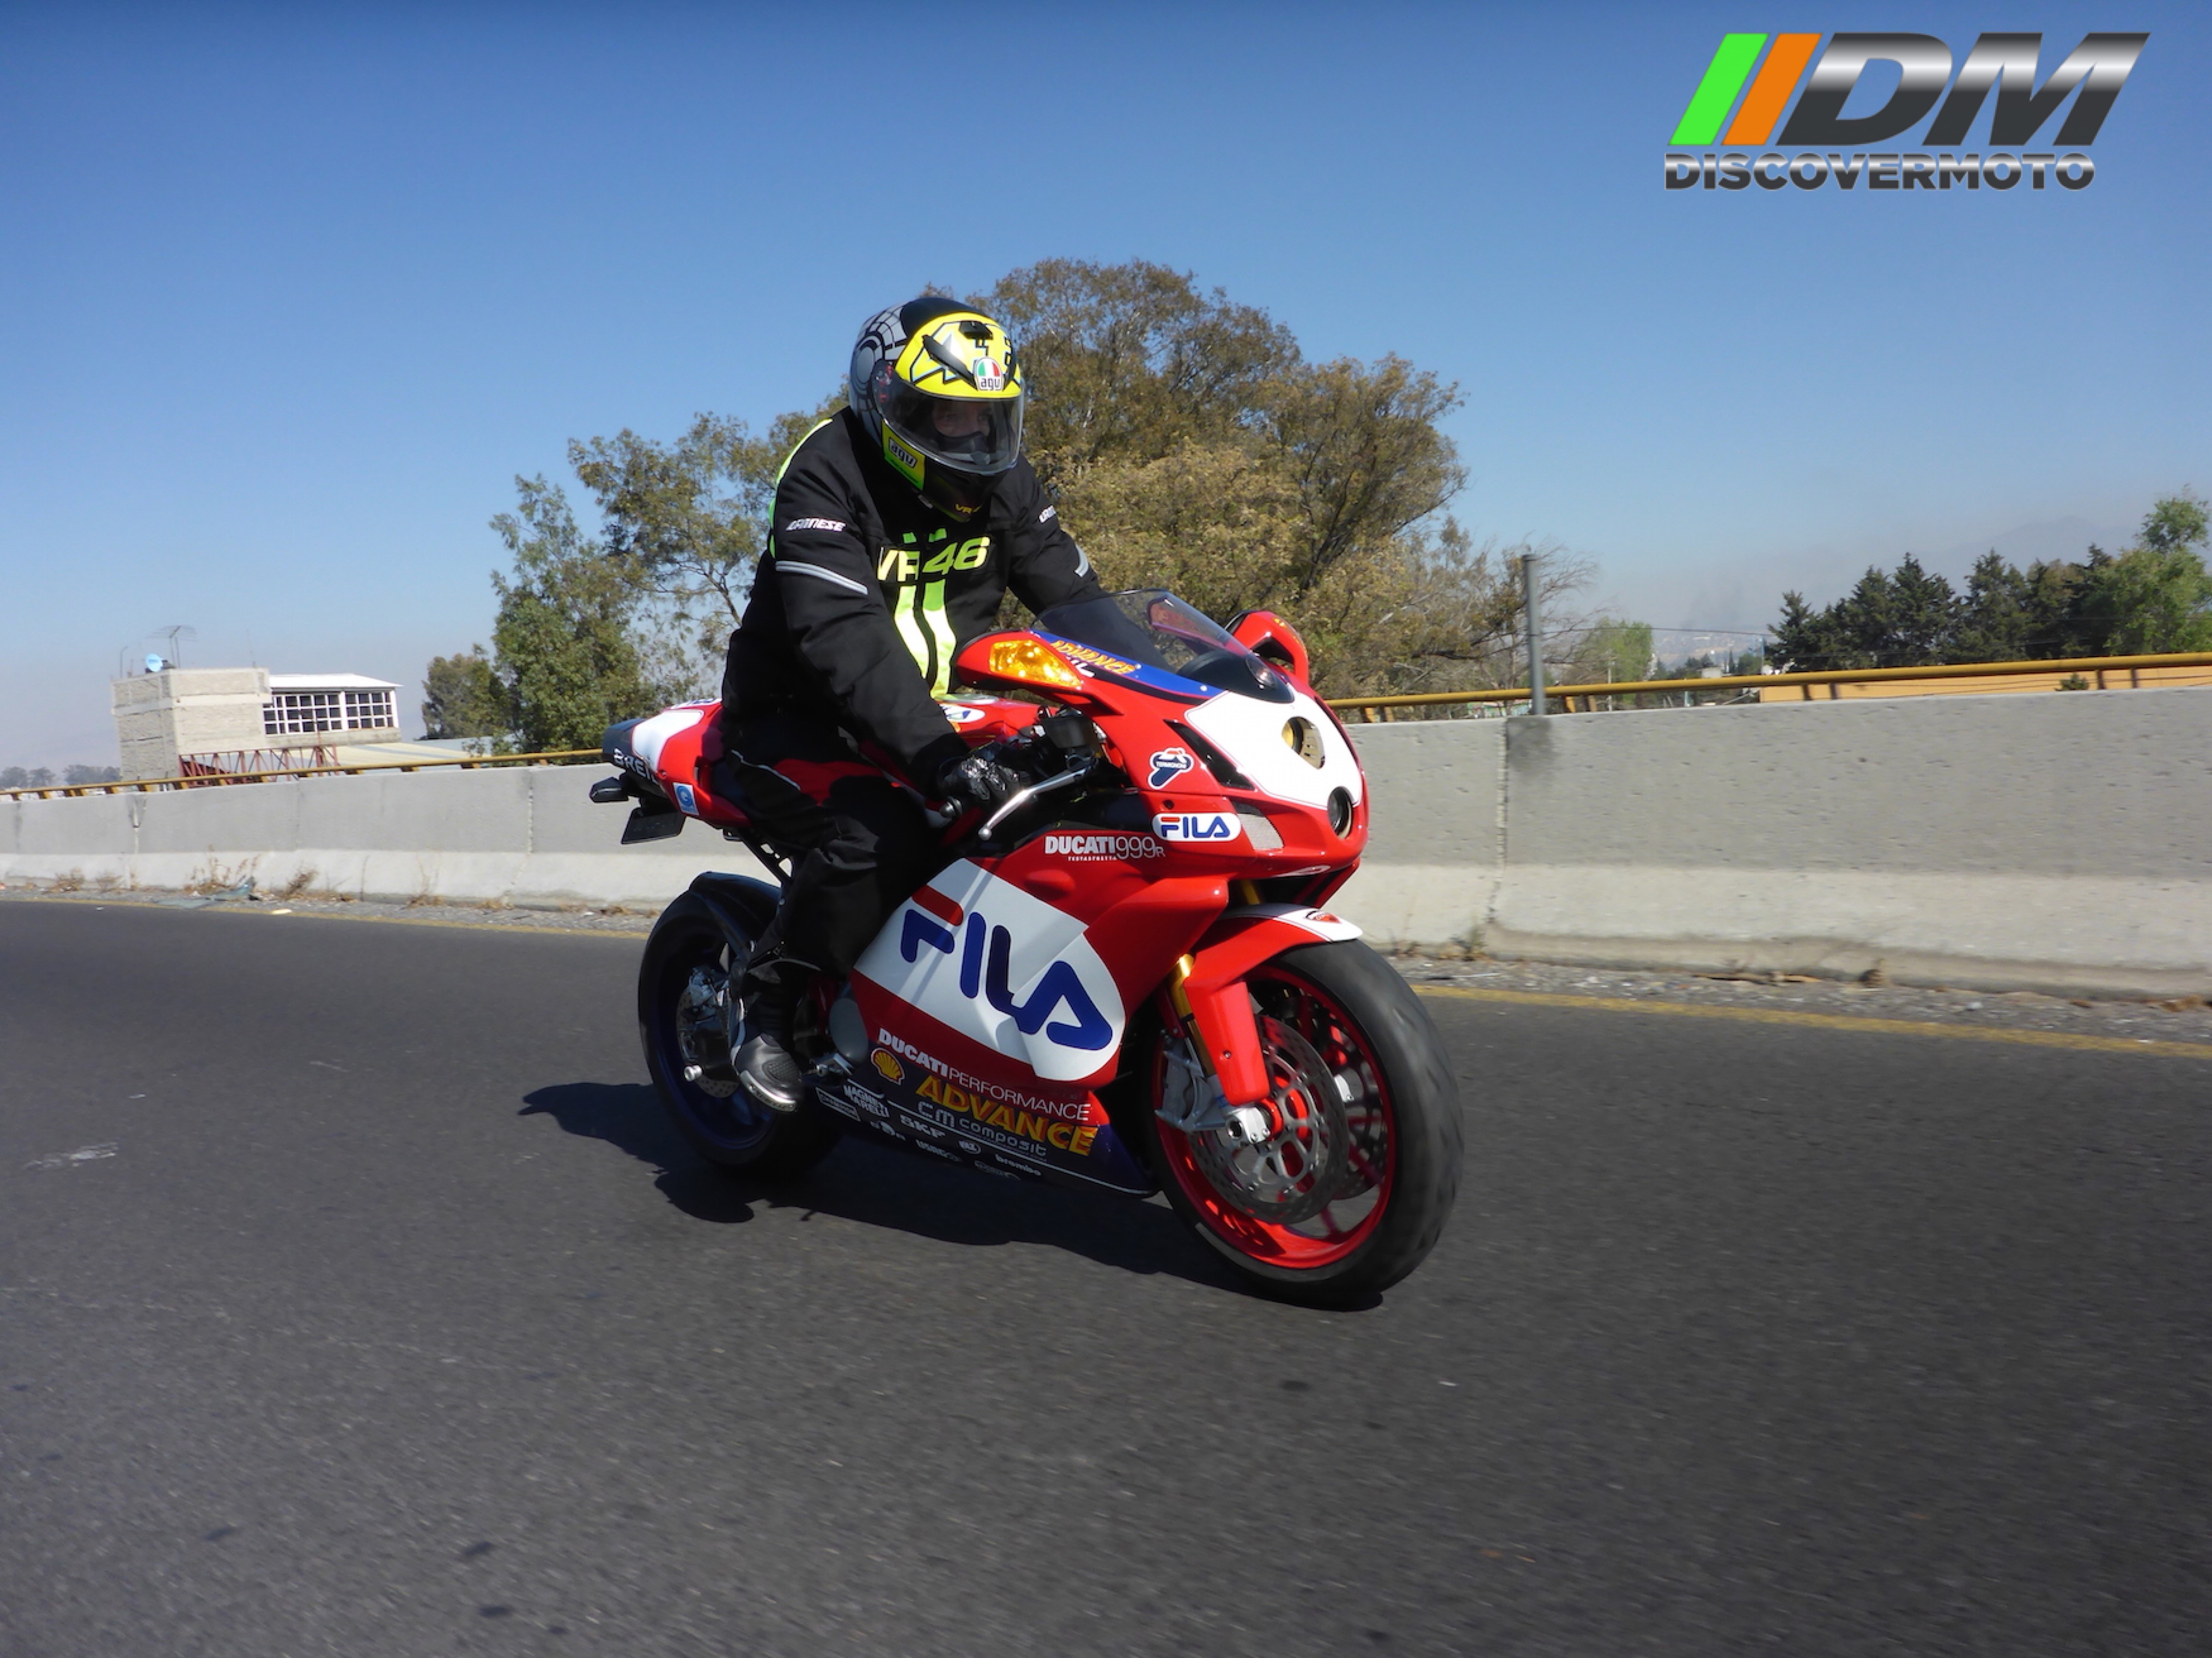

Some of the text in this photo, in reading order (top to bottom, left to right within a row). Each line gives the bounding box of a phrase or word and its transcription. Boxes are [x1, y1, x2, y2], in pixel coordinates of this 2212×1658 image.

[1050, 639, 1136, 674] ADVANCE
[1160, 816, 1231, 838] FILA
[1045, 835, 1115, 855] DUCATI
[900, 885, 1113, 1051] FILA
[878, 1027, 1091, 1121] DUCATI PERFORMANCE
[899, 1113, 946, 1139] SKF
[915, 1075, 1098, 1156] ADVANCE
